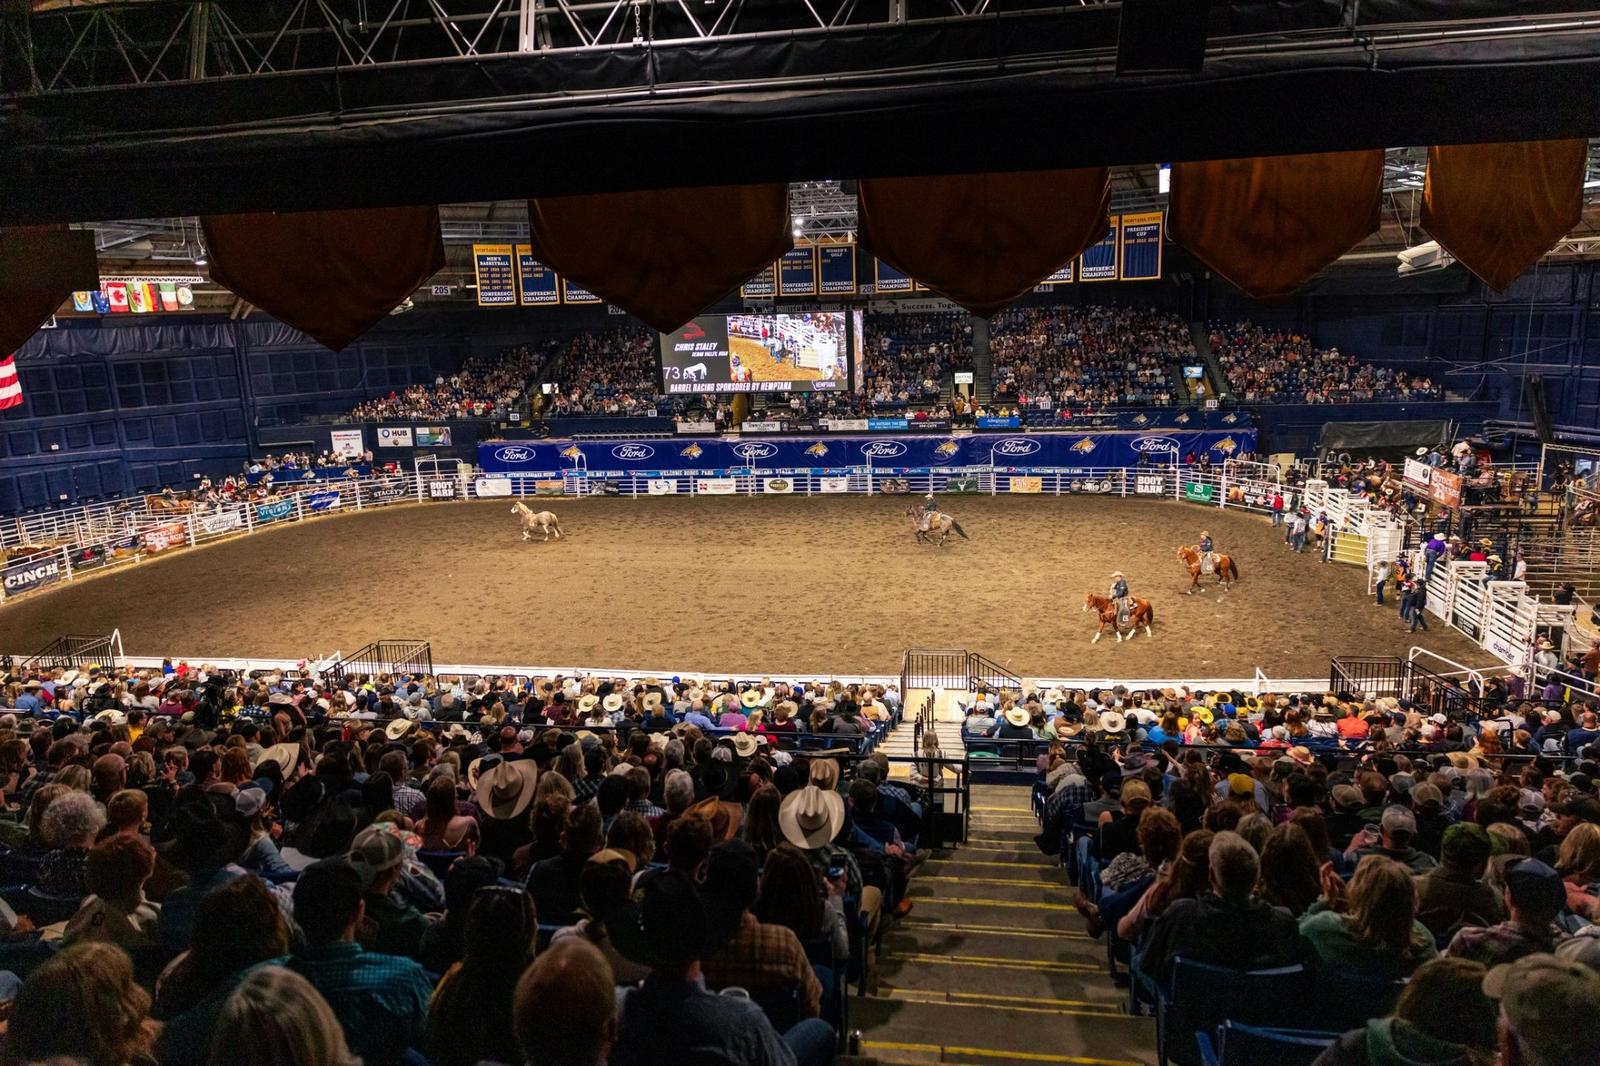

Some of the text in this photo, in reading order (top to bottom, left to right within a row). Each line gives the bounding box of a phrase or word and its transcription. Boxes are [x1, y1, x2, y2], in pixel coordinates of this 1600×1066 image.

[434, 286, 449, 294] 205
[674, 342, 718, 351] CHRIS STALEY
[663, 366, 681, 380] 73
[670, 381, 792, 393] BARREL RACING SPONSORED BY HEMPTANA
[391, 429, 408, 437] HUB
[742, 444, 769, 457] Ford
[870, 442, 898, 455] Ford
[1001, 440, 1031, 454] Ford
[1140, 438, 1169, 452] Ford
[503, 446, 528, 460] Ford
[619, 445, 646, 458] Ford
[429, 481, 454, 489] BOOT
[1137, 475, 1163, 485] BOOT
[373, 488, 404, 498] STACEY'S
[430, 488, 455, 497] BARN
[1137, 484, 1163, 494] BARN
[1239, 485, 1267, 495] NO BULL
[259, 504, 290, 516] VISION
[4, 561, 59, 589] CINCH
